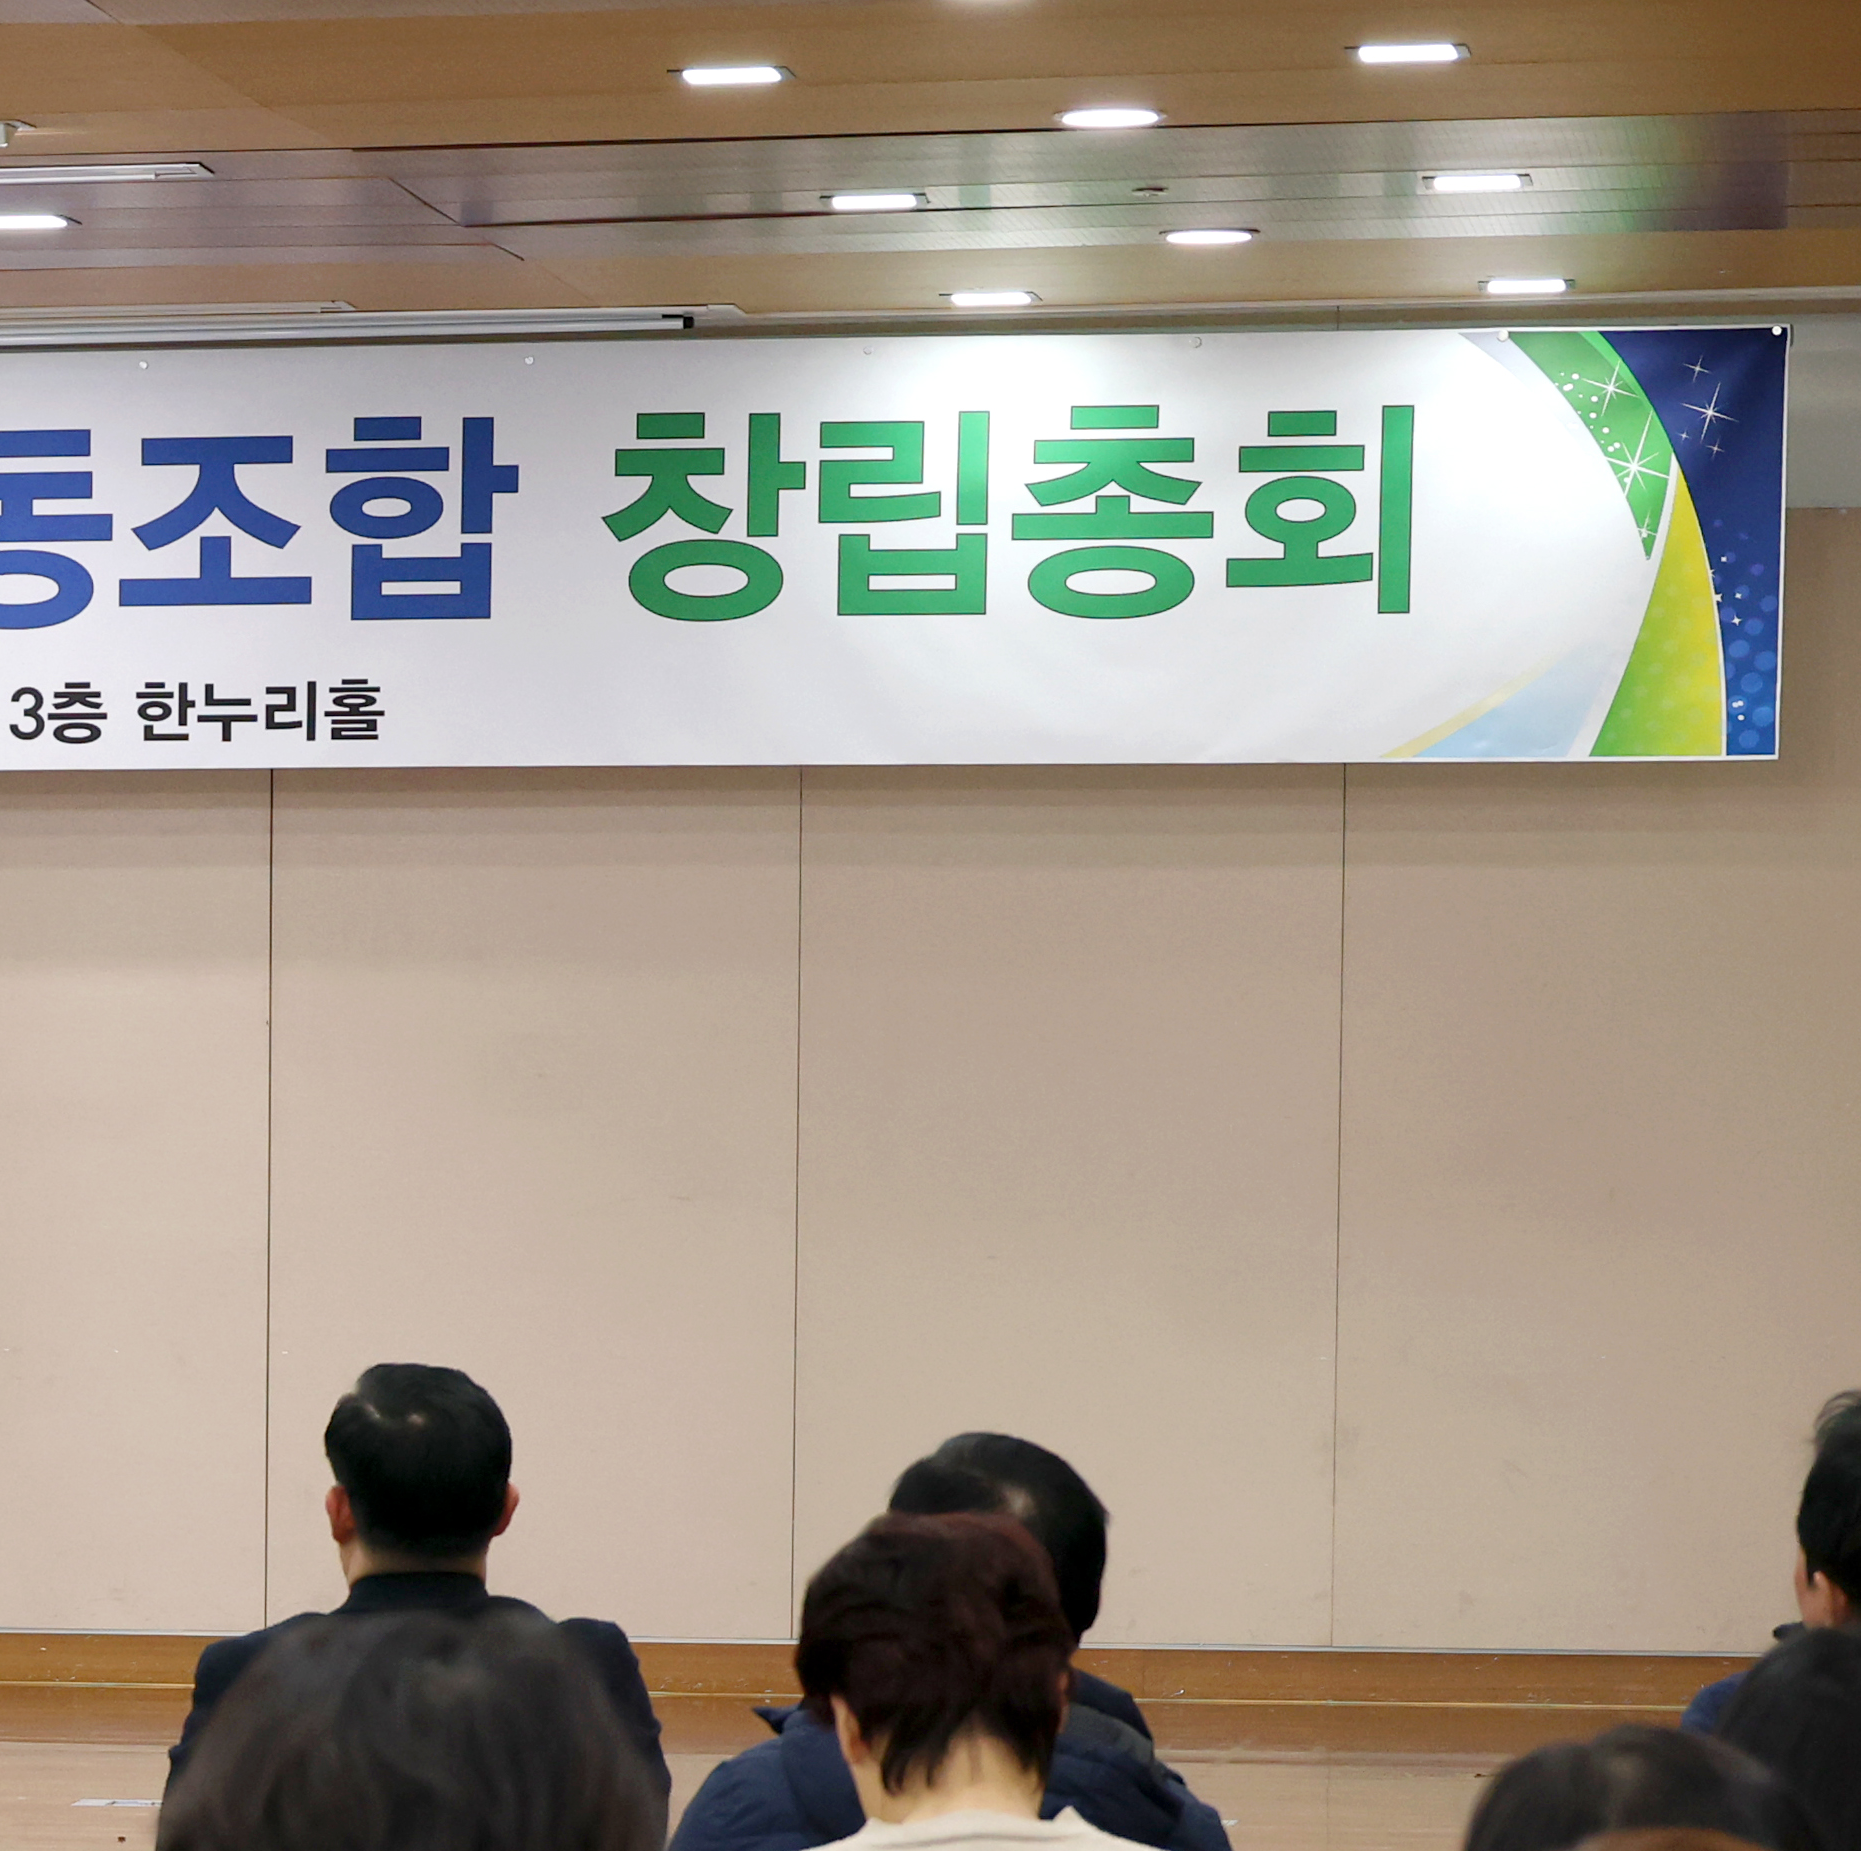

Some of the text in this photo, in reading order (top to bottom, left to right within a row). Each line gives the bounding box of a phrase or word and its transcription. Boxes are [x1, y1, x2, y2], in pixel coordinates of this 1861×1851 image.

[601, 404, 1416, 621] 창립총회
[9, 682, 108, 744] 3층
[135, 678, 386, 742] 한누리홀
